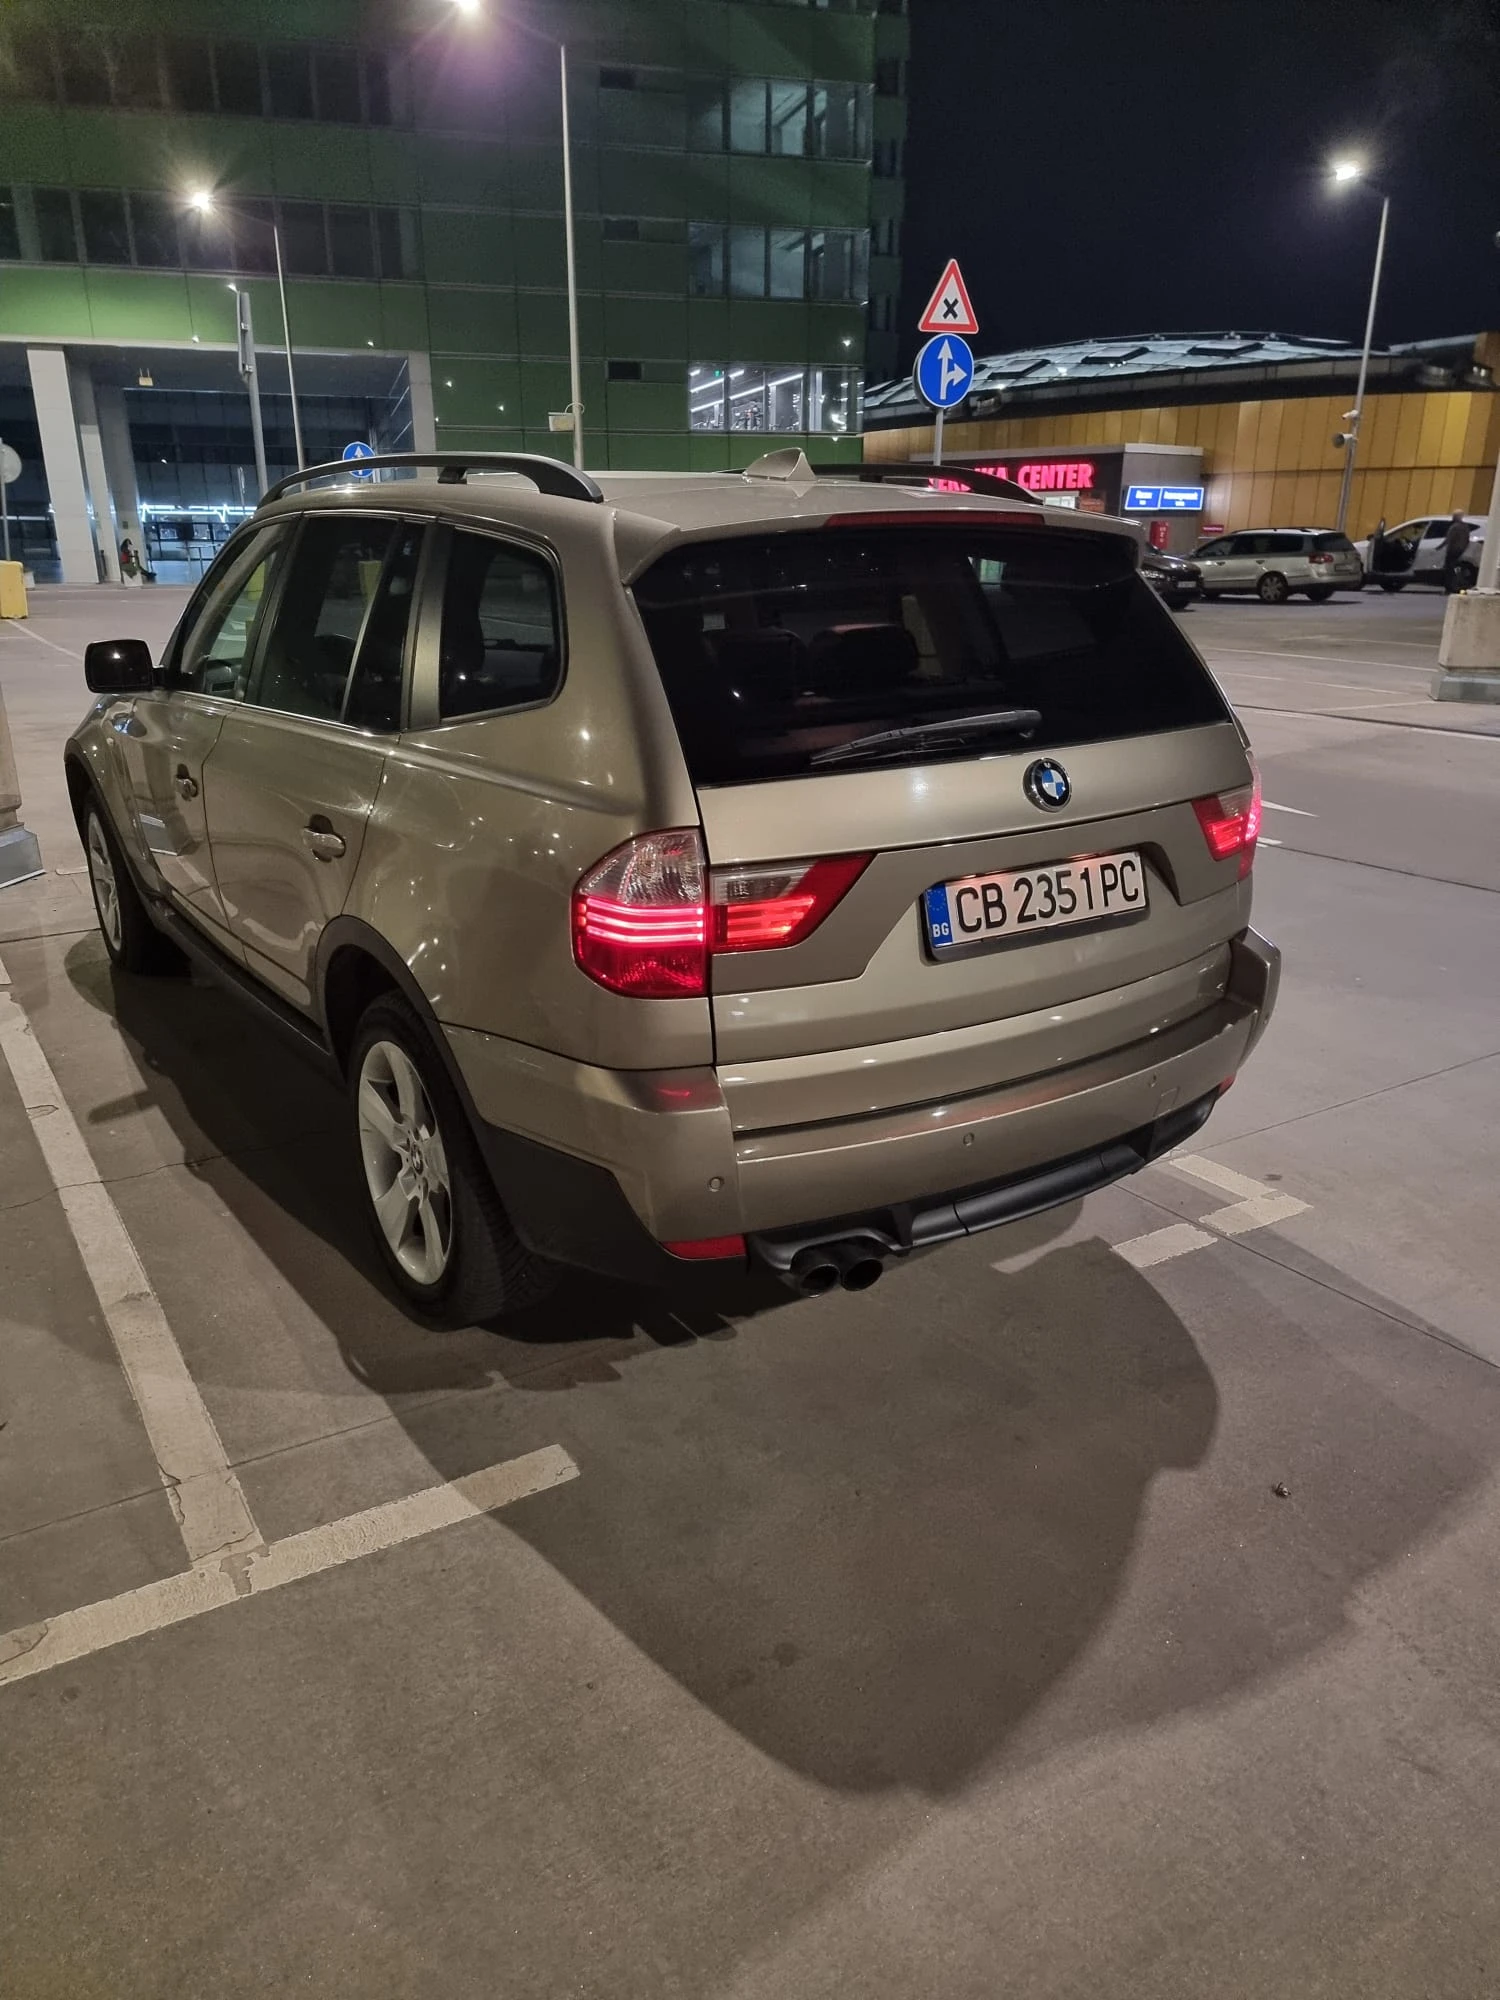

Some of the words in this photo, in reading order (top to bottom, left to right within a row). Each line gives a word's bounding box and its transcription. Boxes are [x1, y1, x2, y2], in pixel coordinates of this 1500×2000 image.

[1018, 464, 1093, 490] CENTER
[956, 882, 1007, 933] CB
[1013, 867, 1095, 924] 2351
[1100, 859, 1139, 907] PC
[932, 923, 950, 938] BG
